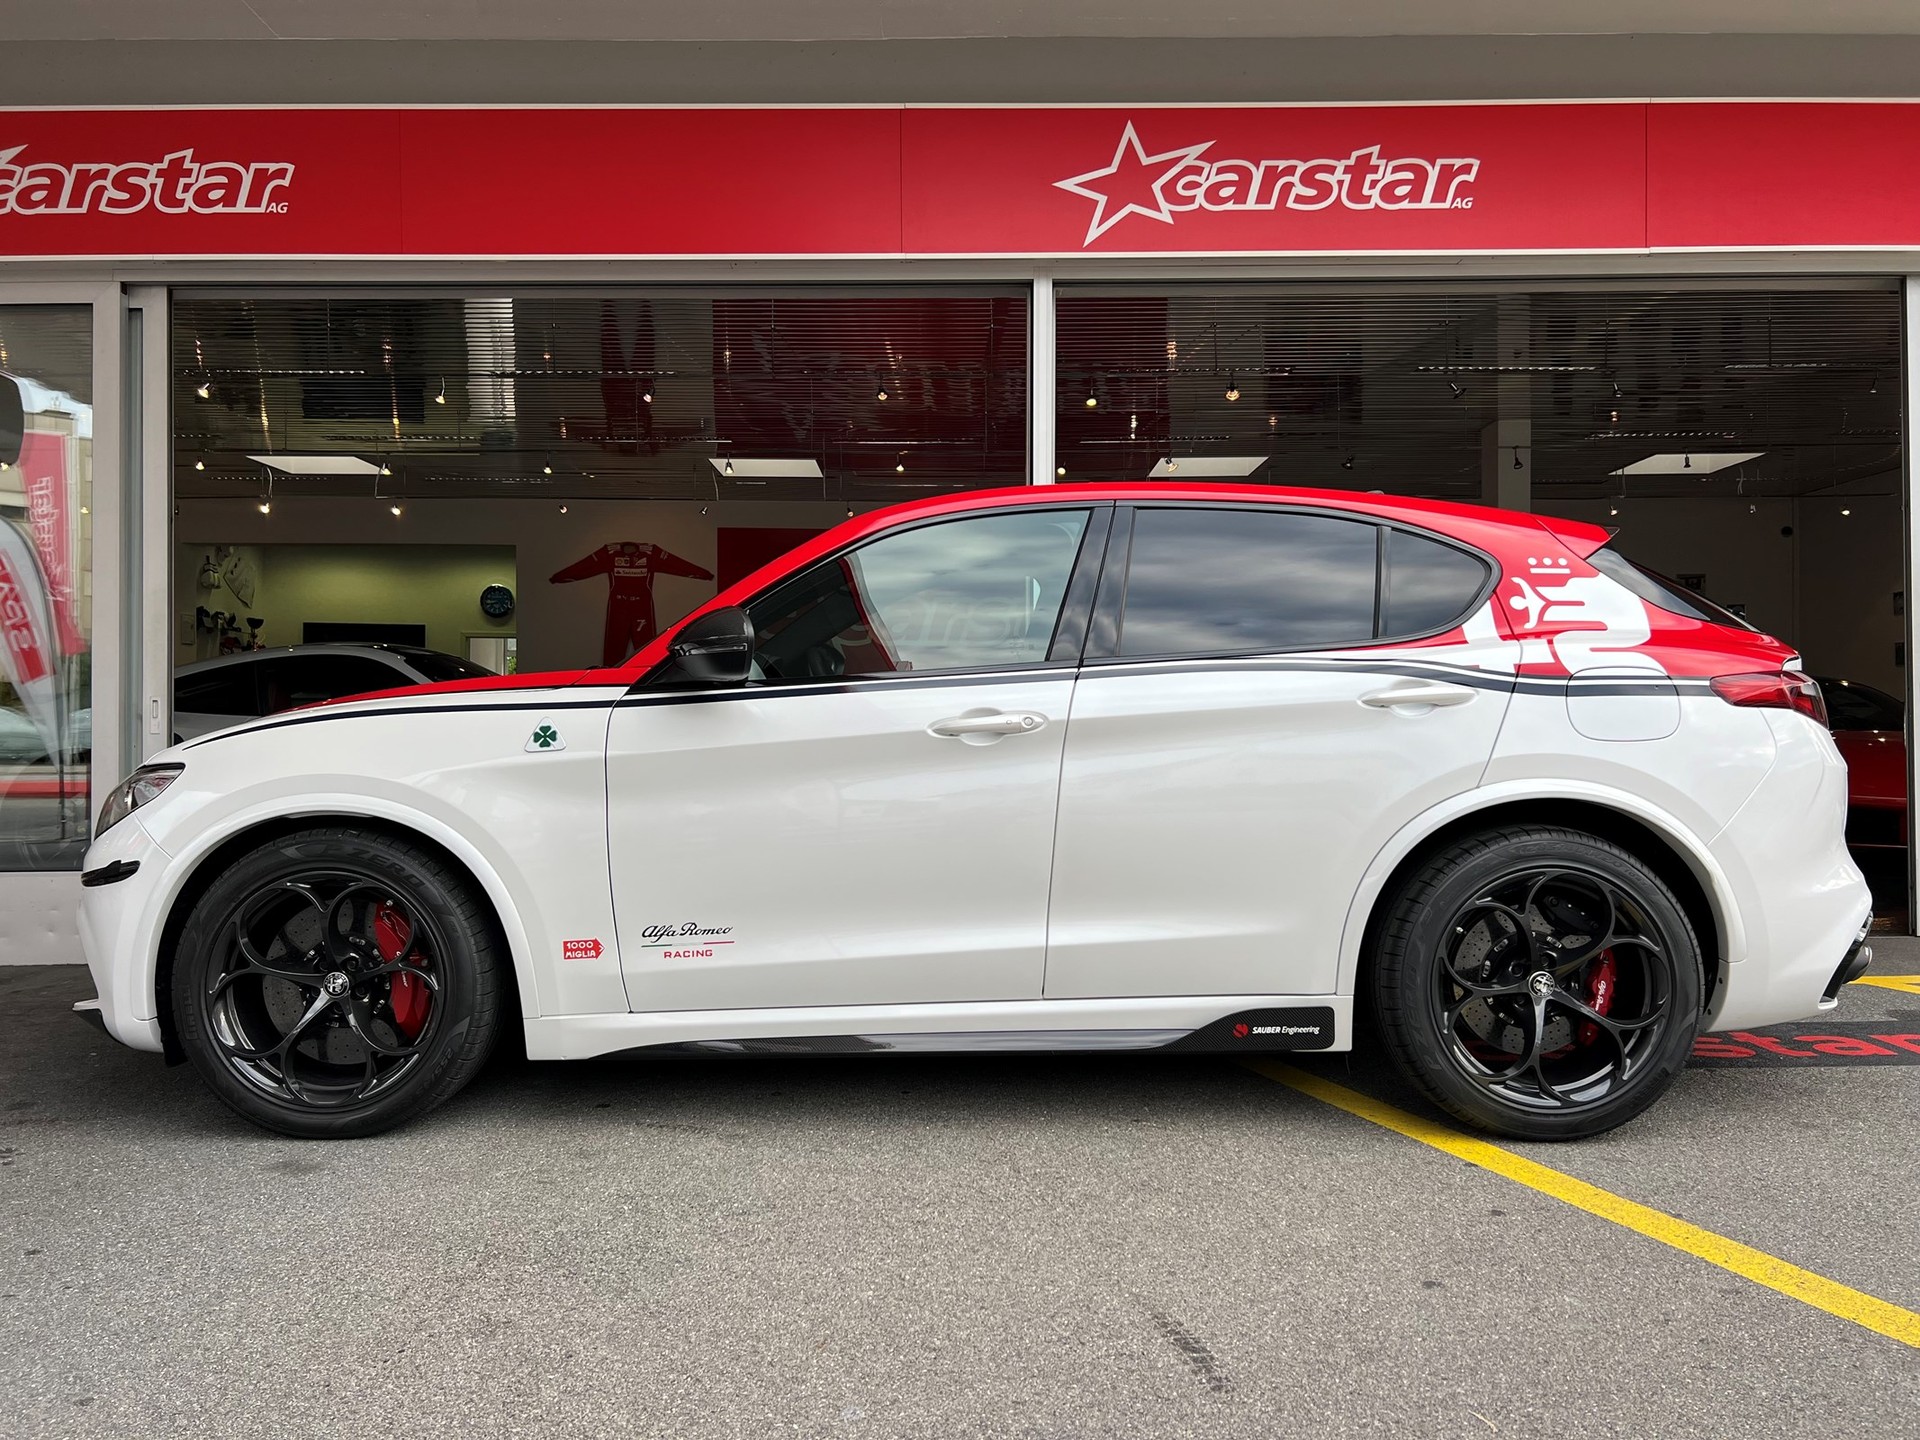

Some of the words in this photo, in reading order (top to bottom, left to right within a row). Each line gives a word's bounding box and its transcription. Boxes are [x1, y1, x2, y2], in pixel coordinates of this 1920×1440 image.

[1160, 144, 1481, 211] carstar
[1451, 197, 1474, 210] AG
[266, 202, 289, 214] AG
[636, 619, 647, 632] 7
[641, 924, 679, 943] Alfa
[678, 922, 734, 937] Romeo
[566, 940, 594, 949] 1000
[565, 949, 597, 959] MIGLIA
[663, 949, 713, 959] RACING
[1251, 1026, 1281, 1035] SAUBER
[1281, 1025, 1321, 1036] Engineering
